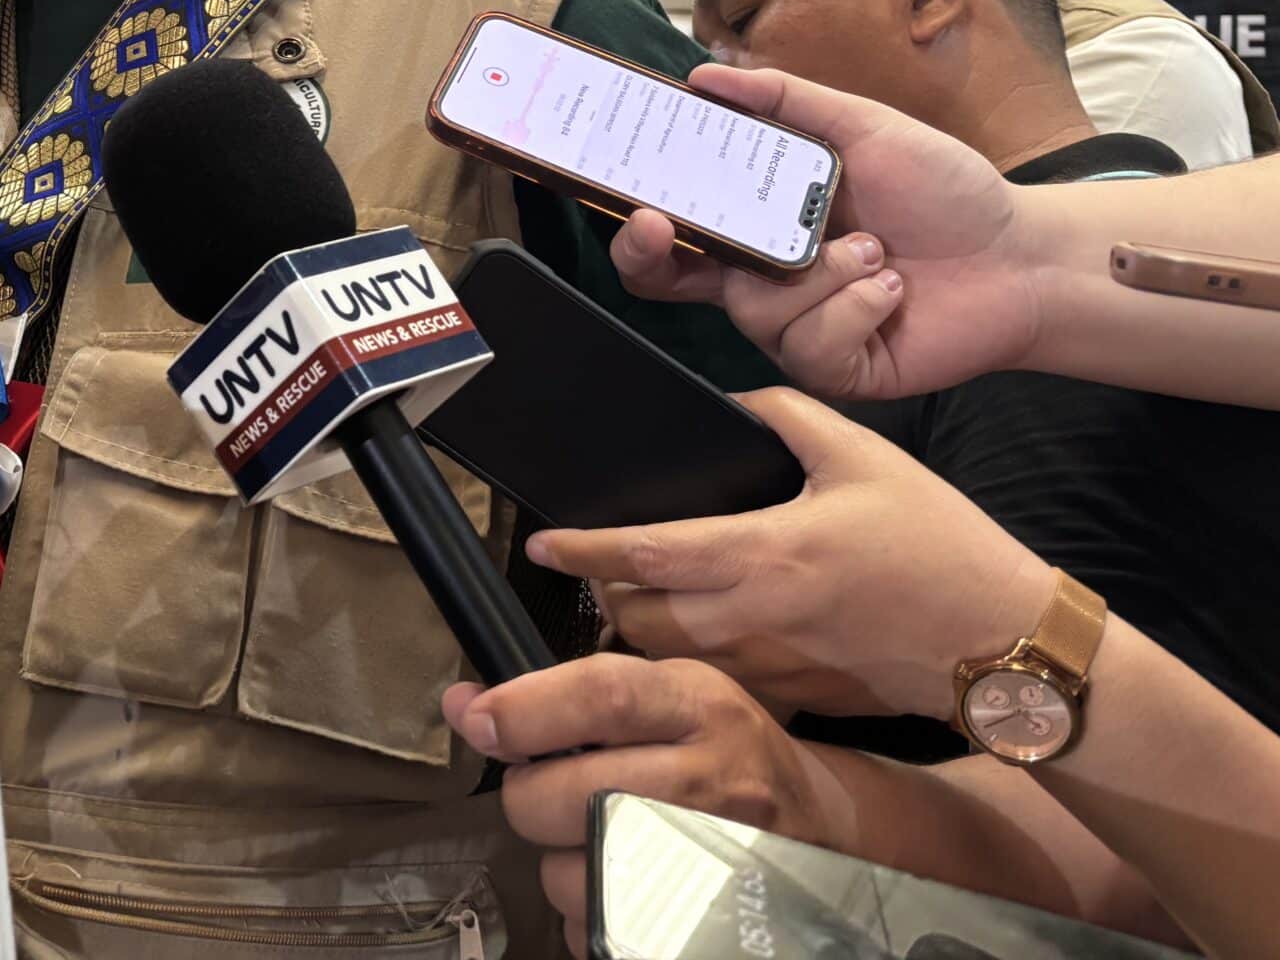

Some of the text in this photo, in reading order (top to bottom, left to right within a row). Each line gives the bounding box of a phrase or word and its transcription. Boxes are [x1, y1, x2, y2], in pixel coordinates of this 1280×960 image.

[754, 135, 789, 203] All Recordings
[322, 264, 435, 322] UNTV
[353, 311, 462, 354] NEWS & RESCUE
[200, 310, 300, 424] UNTV
[229, 359, 328, 458] NEWS & RESCUE
